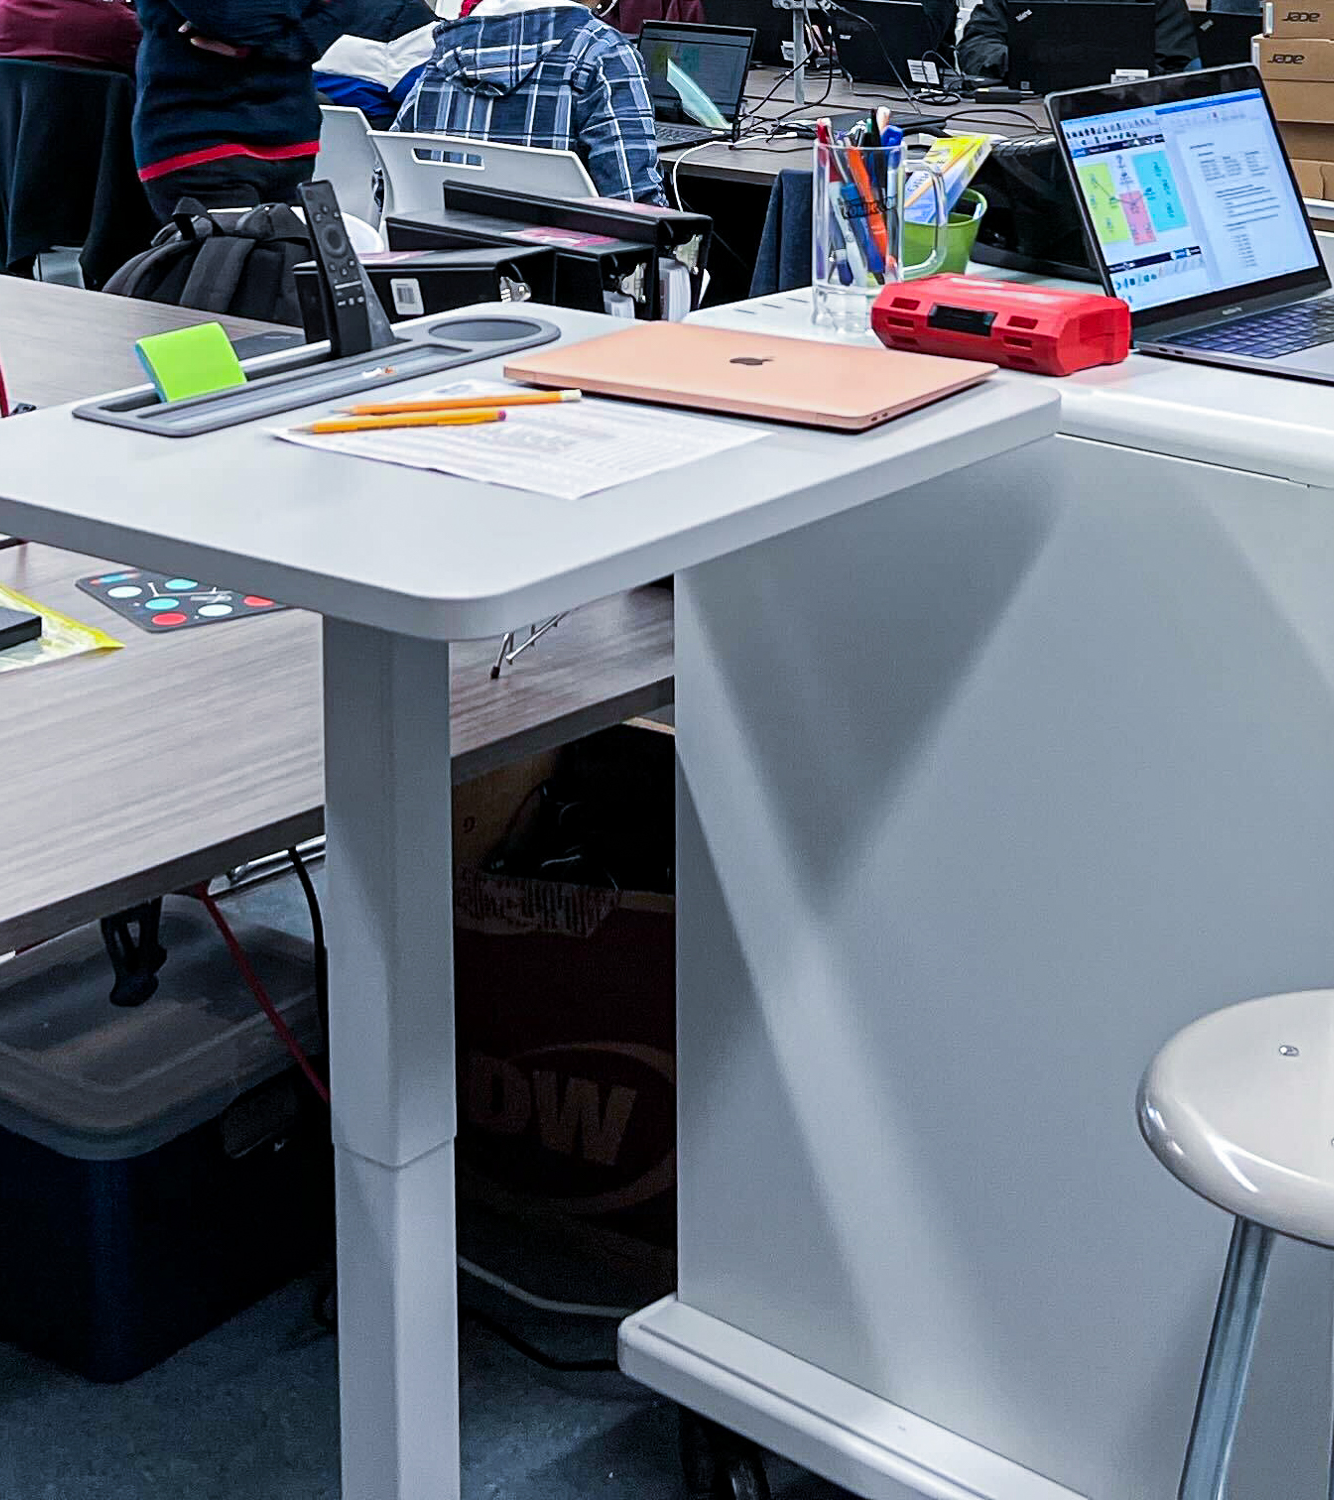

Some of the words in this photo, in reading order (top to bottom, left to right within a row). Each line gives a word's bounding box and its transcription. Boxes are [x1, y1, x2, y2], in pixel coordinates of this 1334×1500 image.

[1281, 11, 1321, 22] acer
[1267, 54, 1306, 65] acer
[466, 1053, 638, 1166] DW
